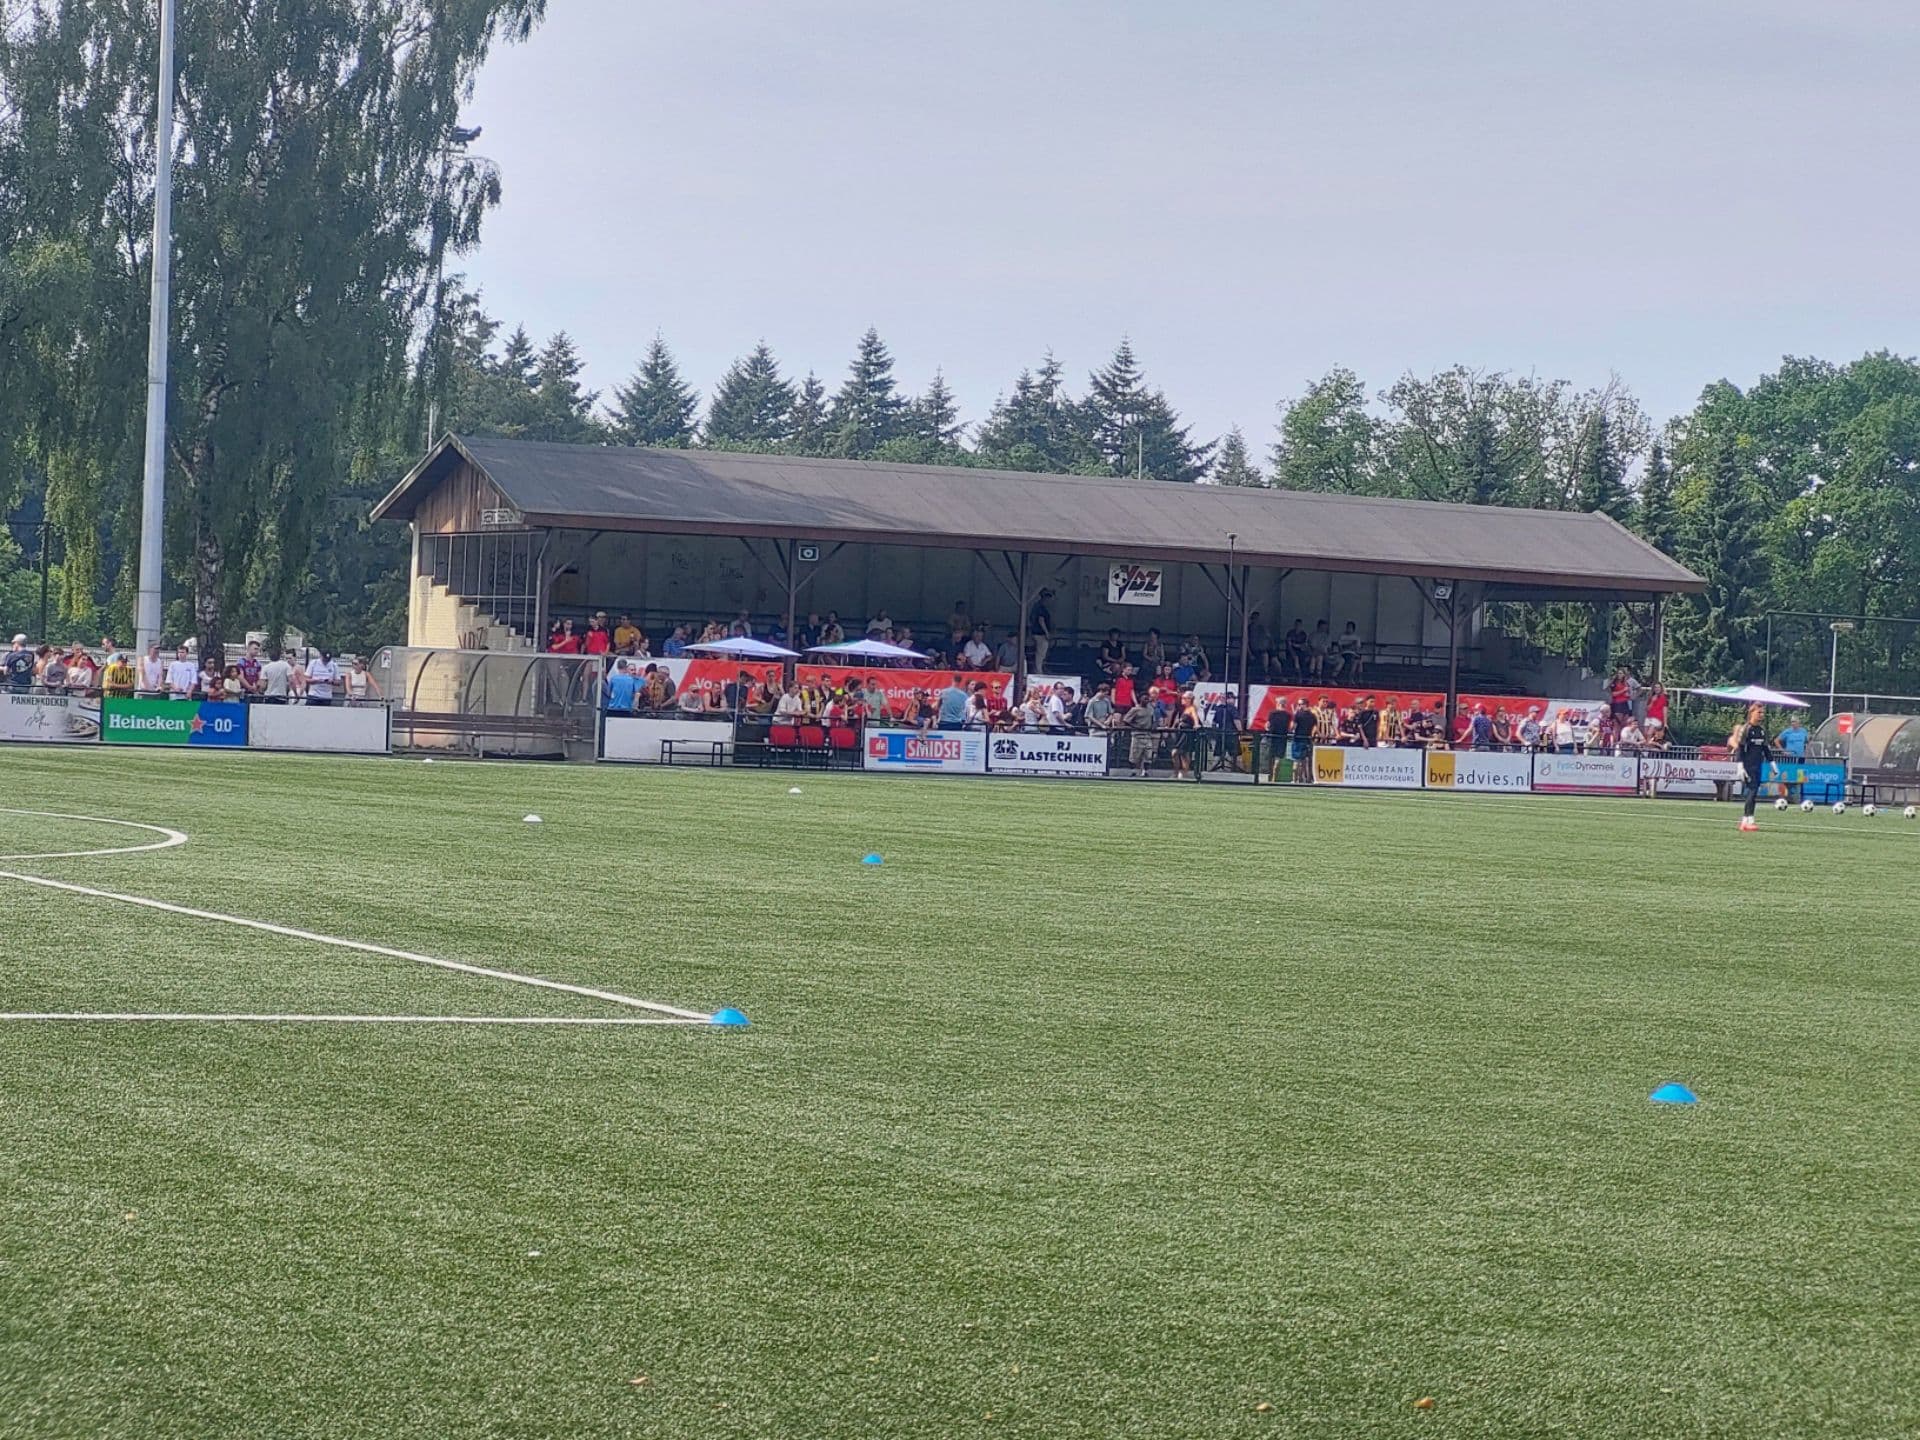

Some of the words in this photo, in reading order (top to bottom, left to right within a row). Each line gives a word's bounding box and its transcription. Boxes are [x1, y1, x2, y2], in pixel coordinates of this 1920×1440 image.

[887, 686, 919, 699] sind
[109, 713, 185, 731] Heineken
[875, 739, 886, 751] de
[907, 739, 960, 759] SMIDSE
[1056, 740, 1072, 752] RJ
[1020, 751, 1103, 764] LASTECHNIEK
[1318, 764, 1341, 780] bvr
[1344, 764, 1415, 774] ACCOUNTANTS
[1429, 767, 1453, 783] bvr
[1456, 770, 1530, 787] advies.nl
